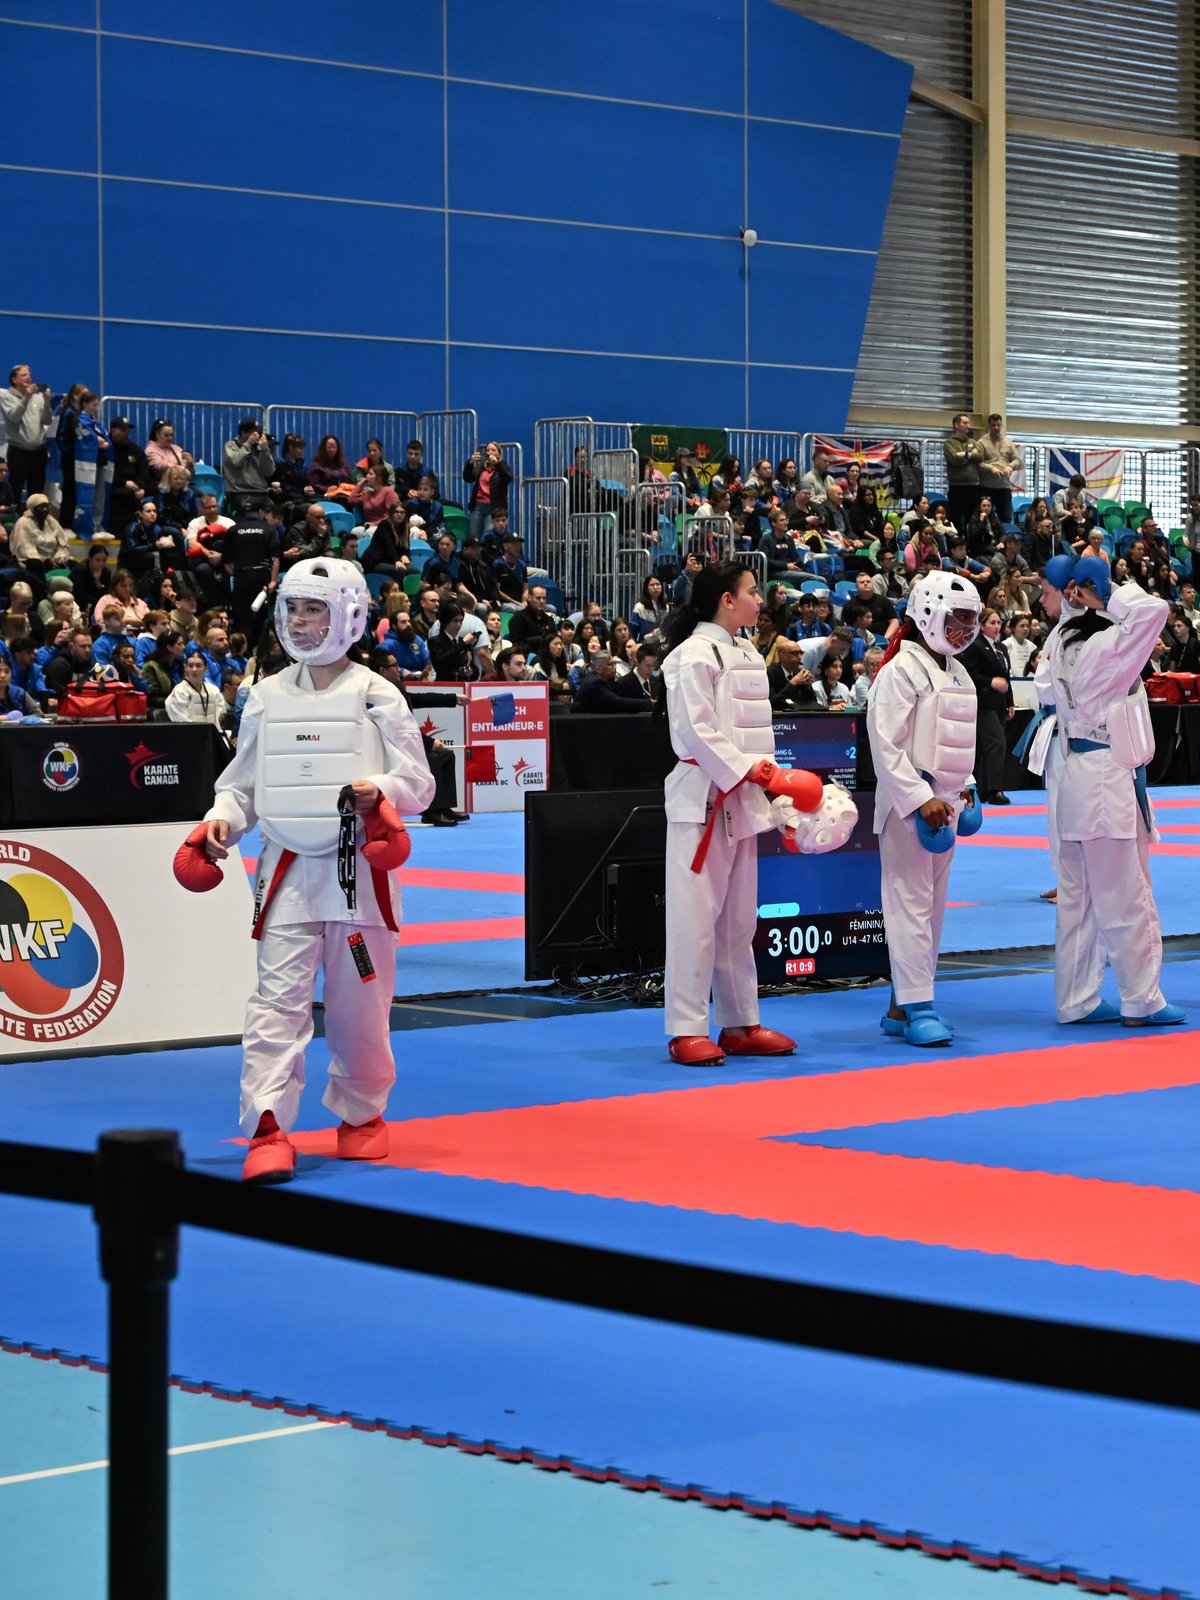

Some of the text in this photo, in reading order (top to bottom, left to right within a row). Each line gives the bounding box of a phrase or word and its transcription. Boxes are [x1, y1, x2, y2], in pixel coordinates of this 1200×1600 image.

[850, 722, 856, 734] 1
[50, 761, 72, 772] WKF
[143, 765, 179, 775] KARATE
[144, 775, 179, 786] CANADA
[842, 936, 857, 946] U14
[859, 935, 871, 944] -47
[873, 933, 883, 943] KG
[785, 961, 813, 973] R1 0:9
[0, 979, 118, 1040] TE FEDERATION
